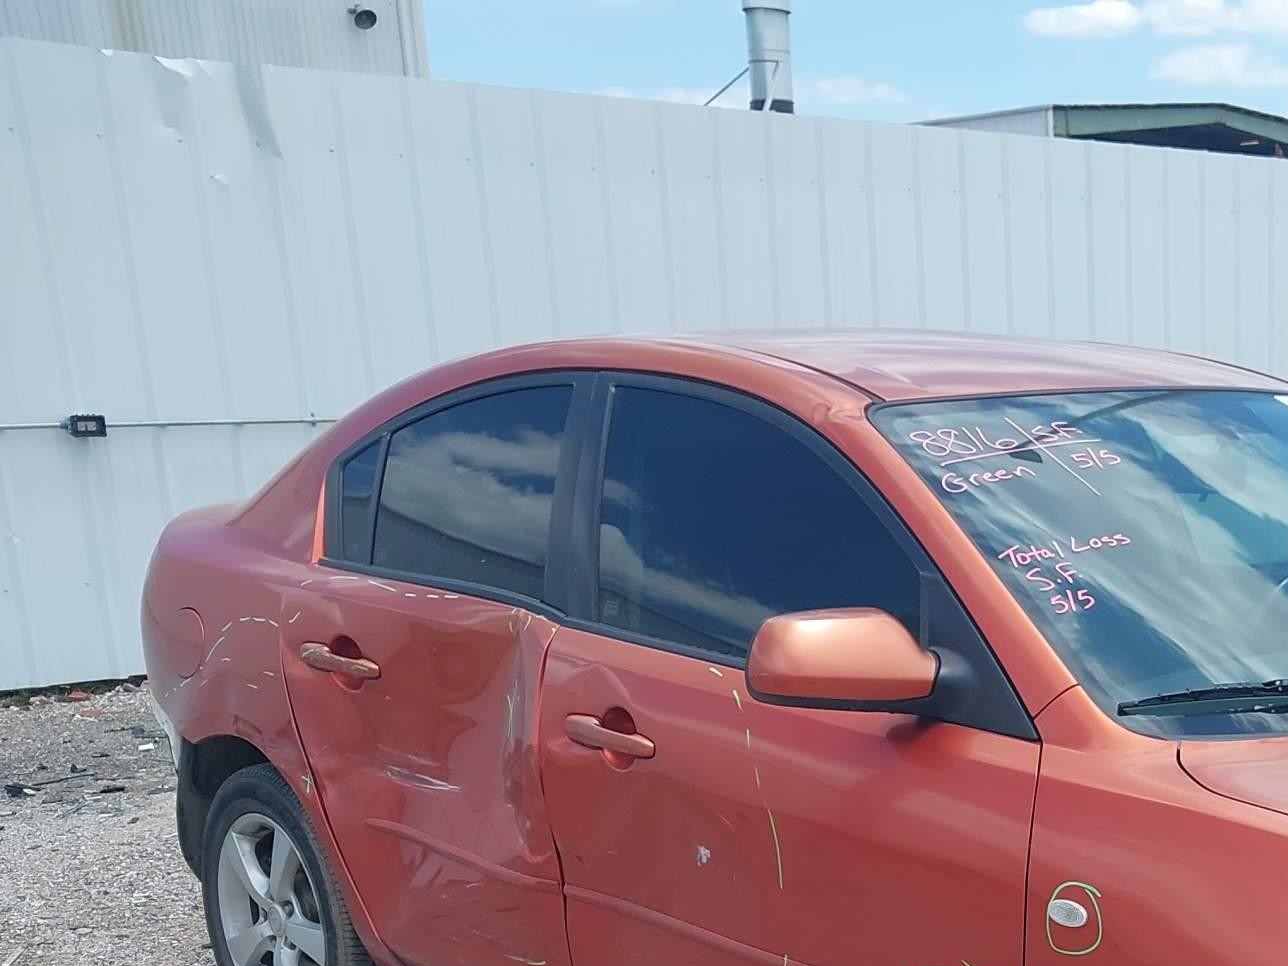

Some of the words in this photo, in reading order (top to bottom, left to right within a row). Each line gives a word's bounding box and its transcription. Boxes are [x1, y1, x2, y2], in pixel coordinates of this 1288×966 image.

[909, 426, 1019, 456] 8816
[940, 465, 1037, 493] Green
[998, 540, 1065, 568] Total
[1070, 533, 1132, 552] Loss
[1025, 562, 1083, 591] S.F.
